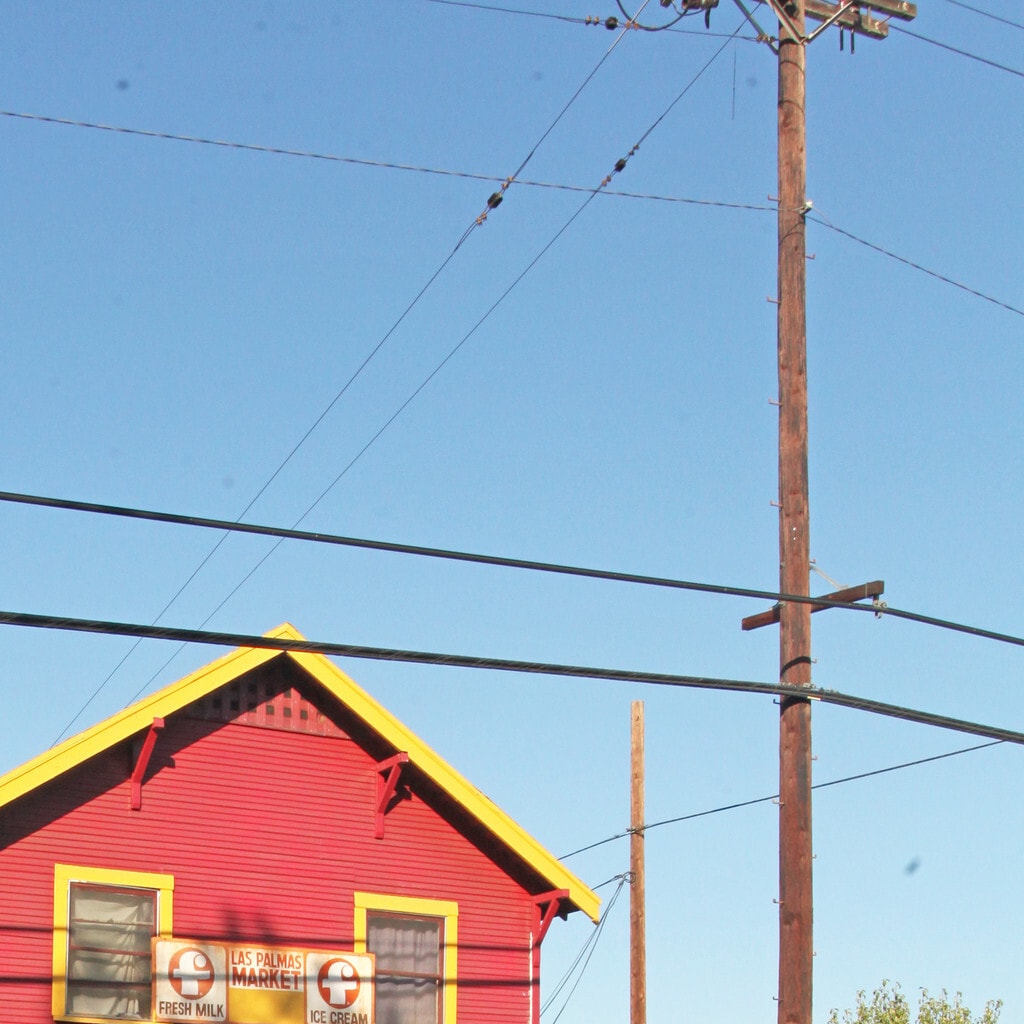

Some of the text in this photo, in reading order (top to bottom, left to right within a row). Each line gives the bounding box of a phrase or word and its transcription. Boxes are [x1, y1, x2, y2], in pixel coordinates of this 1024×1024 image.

[231, 950, 302, 970] LAS PALMAS
[232, 966, 301, 990] MARKET
[158, 1000, 224, 1018] FRESH MILK
[310, 1009, 327, 1024] ICE
